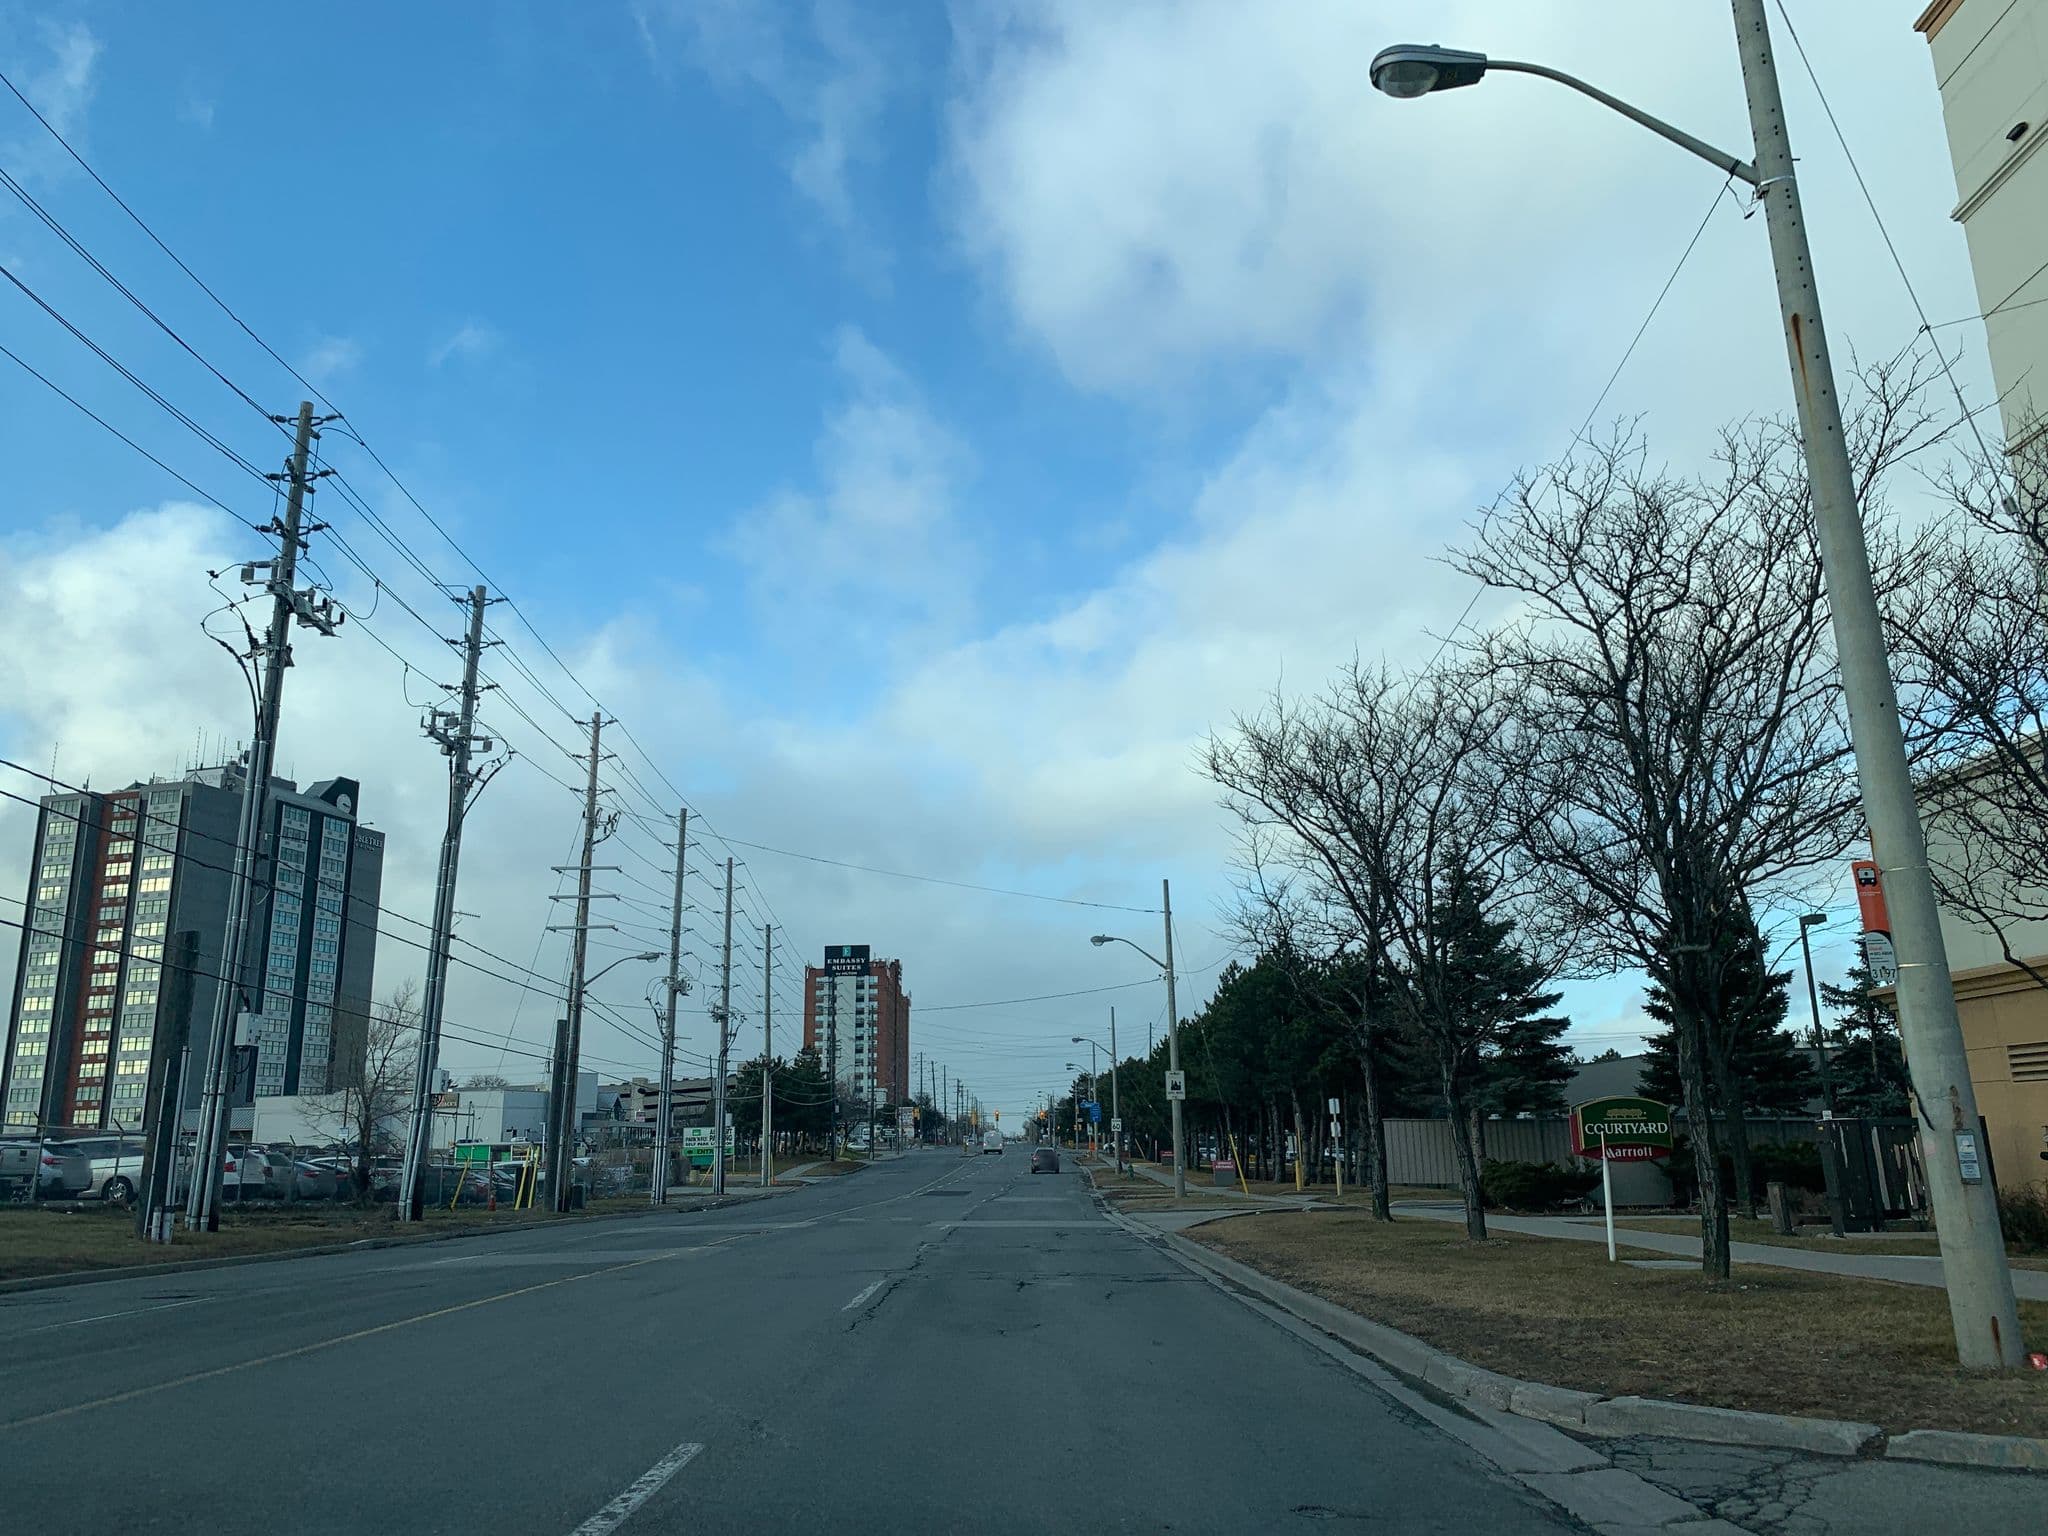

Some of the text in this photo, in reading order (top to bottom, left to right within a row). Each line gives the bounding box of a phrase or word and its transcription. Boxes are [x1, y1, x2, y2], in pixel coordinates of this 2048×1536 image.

[1871, 968, 1896, 979] 3197
[1584, 1122, 1668, 1135] COURTYARD
[1604, 1146, 1653, 1159] Marriott
